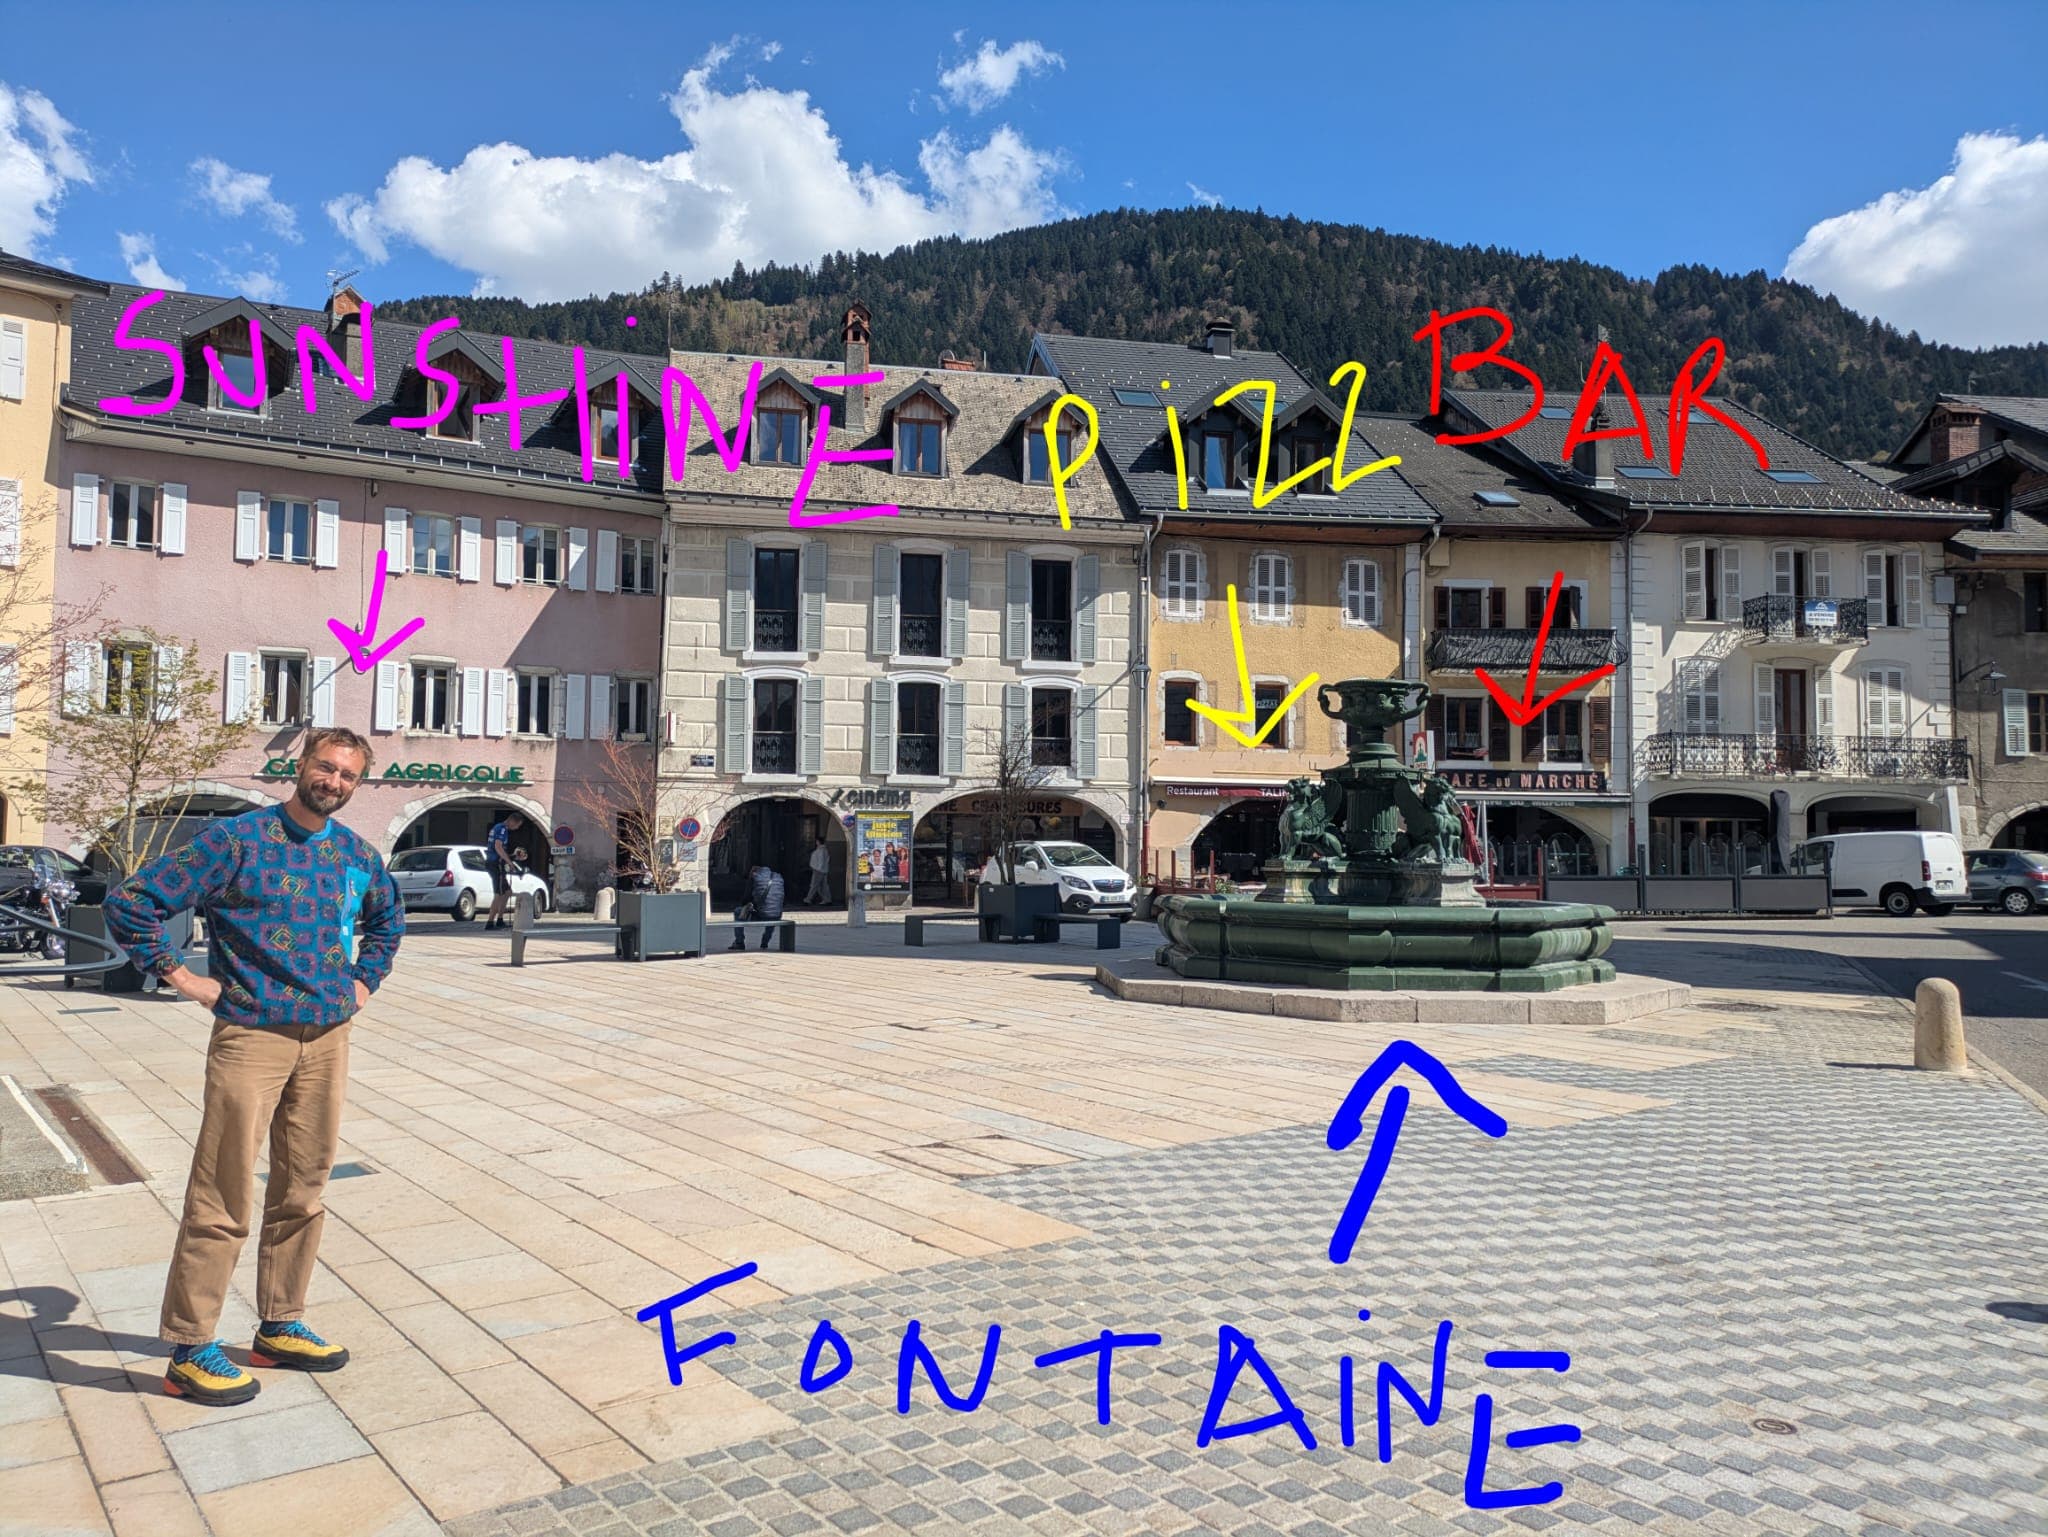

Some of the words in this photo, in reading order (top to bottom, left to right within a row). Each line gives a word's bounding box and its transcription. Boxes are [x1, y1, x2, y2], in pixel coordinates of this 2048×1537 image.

[386, 762, 525, 783] AGRICOLE
[1520, 771, 1598, 789] MARCHÉ
[1167, 786, 1219, 796] Restaurant
[971, 798, 1062, 815] CHASURES
